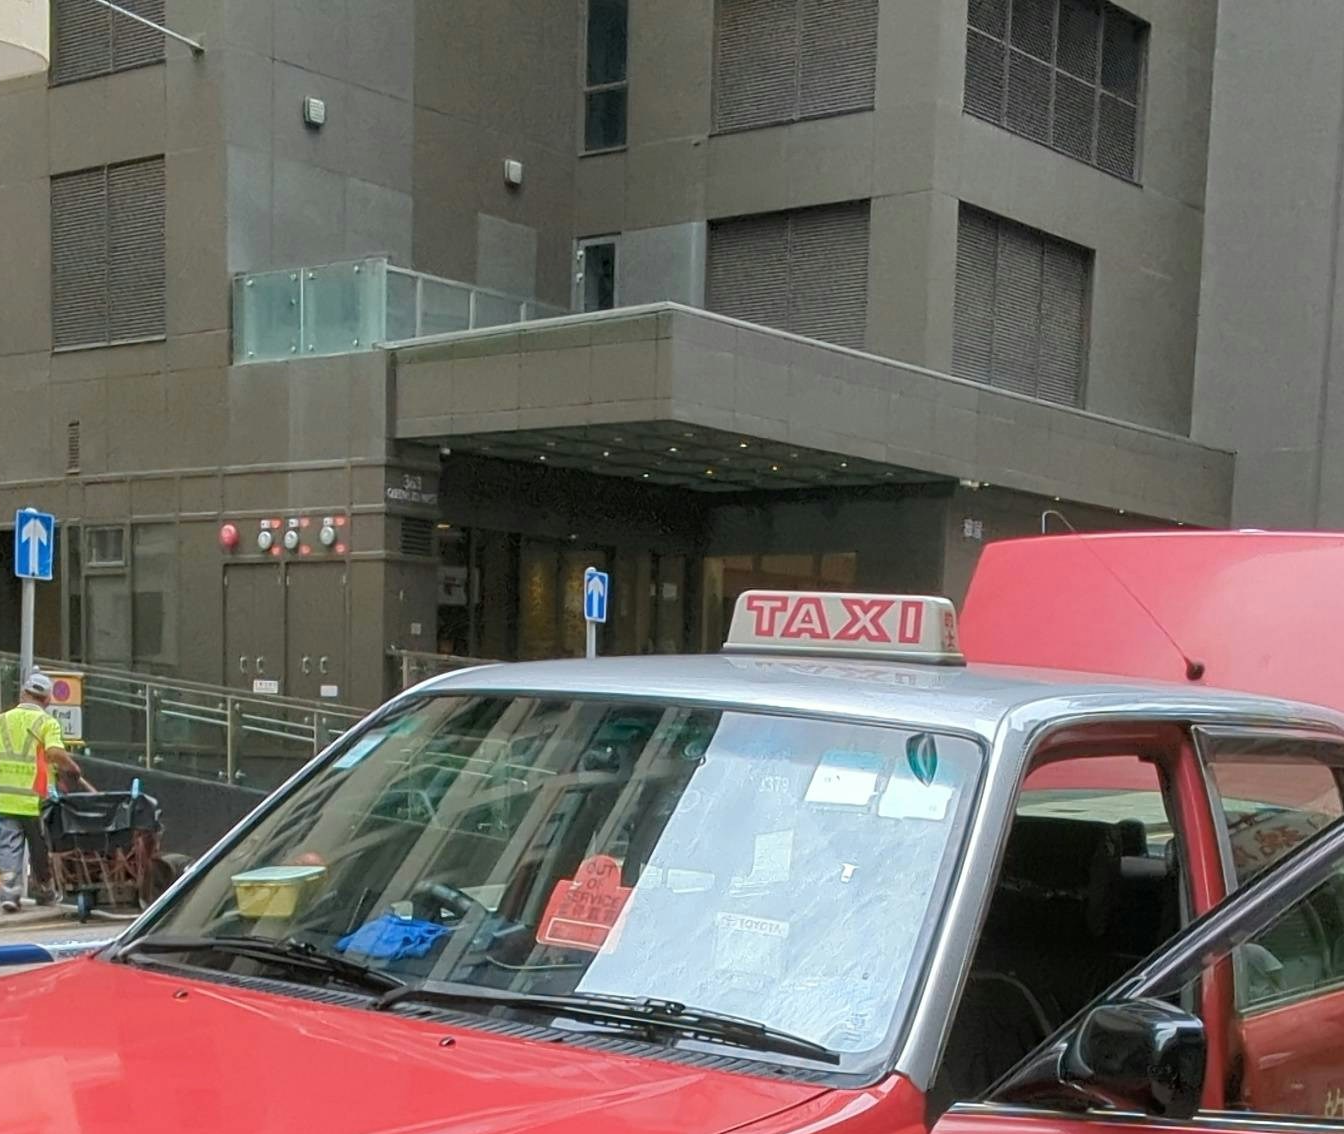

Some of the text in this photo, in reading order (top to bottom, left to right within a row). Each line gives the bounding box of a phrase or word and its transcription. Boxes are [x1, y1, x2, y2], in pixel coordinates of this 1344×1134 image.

[746, 595, 924, 644] TAXI
[587, 862, 616, 875] OUT
[739, 918, 782, 934] TOYOTA
